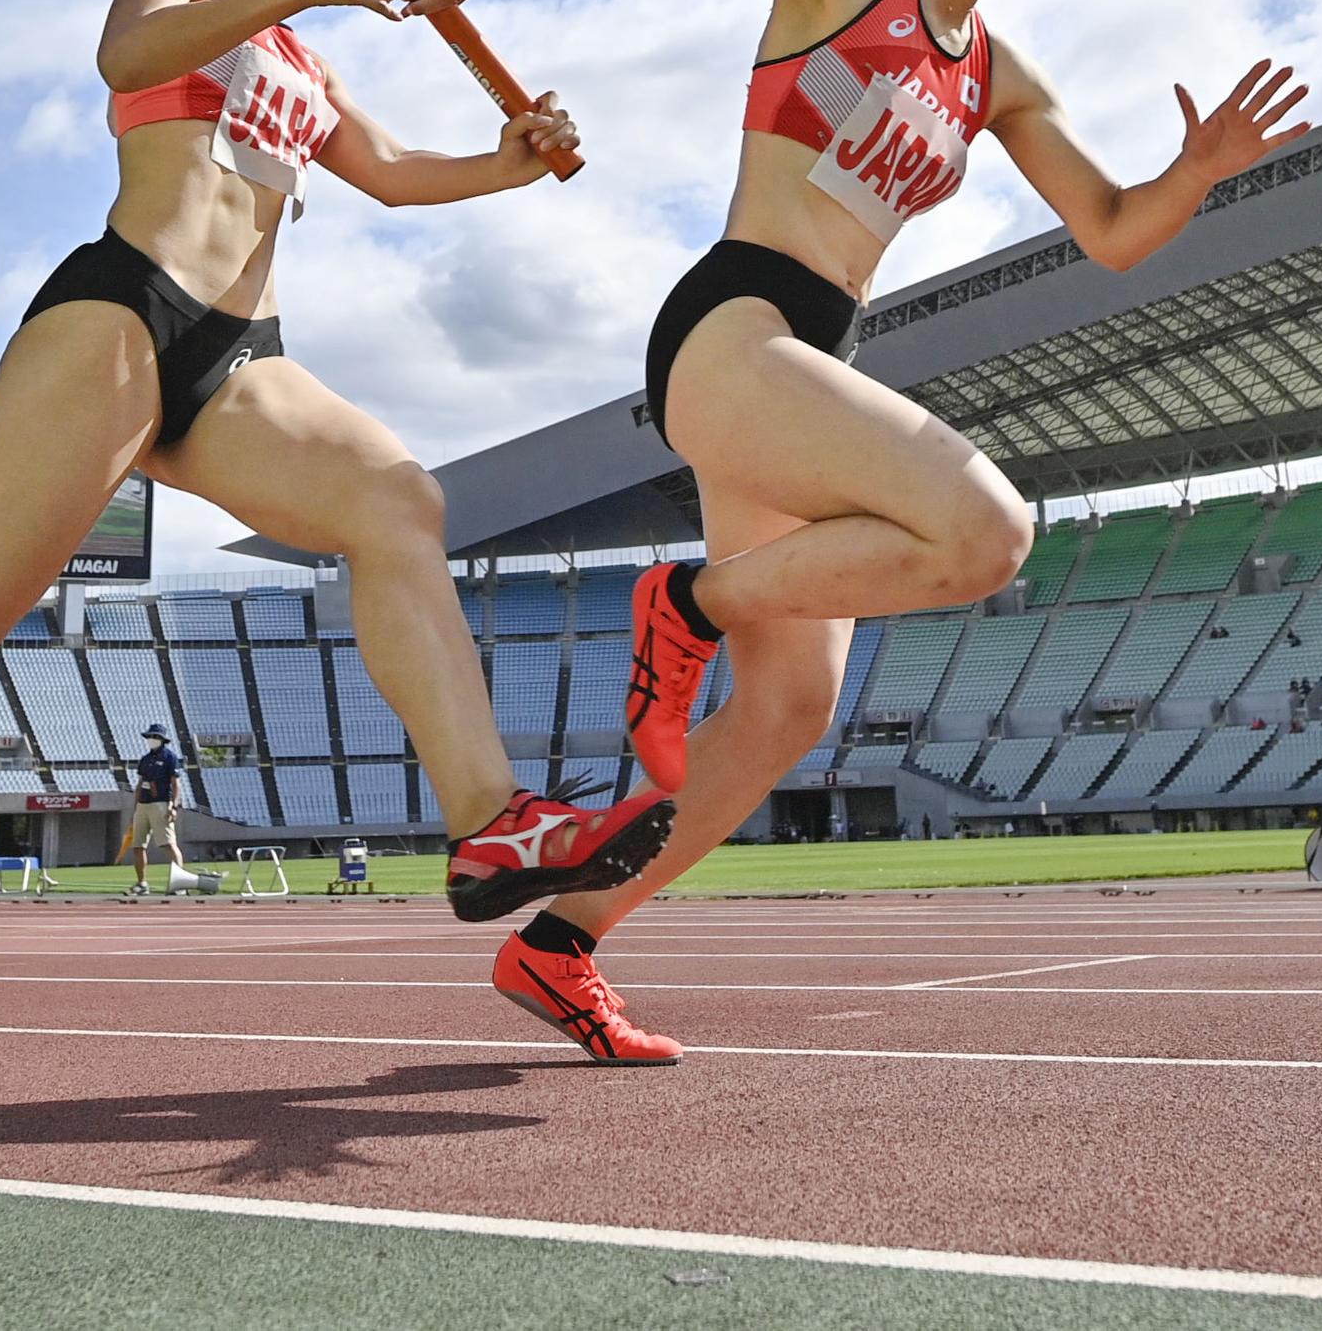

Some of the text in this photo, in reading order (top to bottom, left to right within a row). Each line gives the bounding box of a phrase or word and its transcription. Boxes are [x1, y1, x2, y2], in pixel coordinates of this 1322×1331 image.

[885, 65, 967, 138] JAPAN
[836, 107, 962, 220] JAPAN
[71, 559, 119, 574] NAGAI
